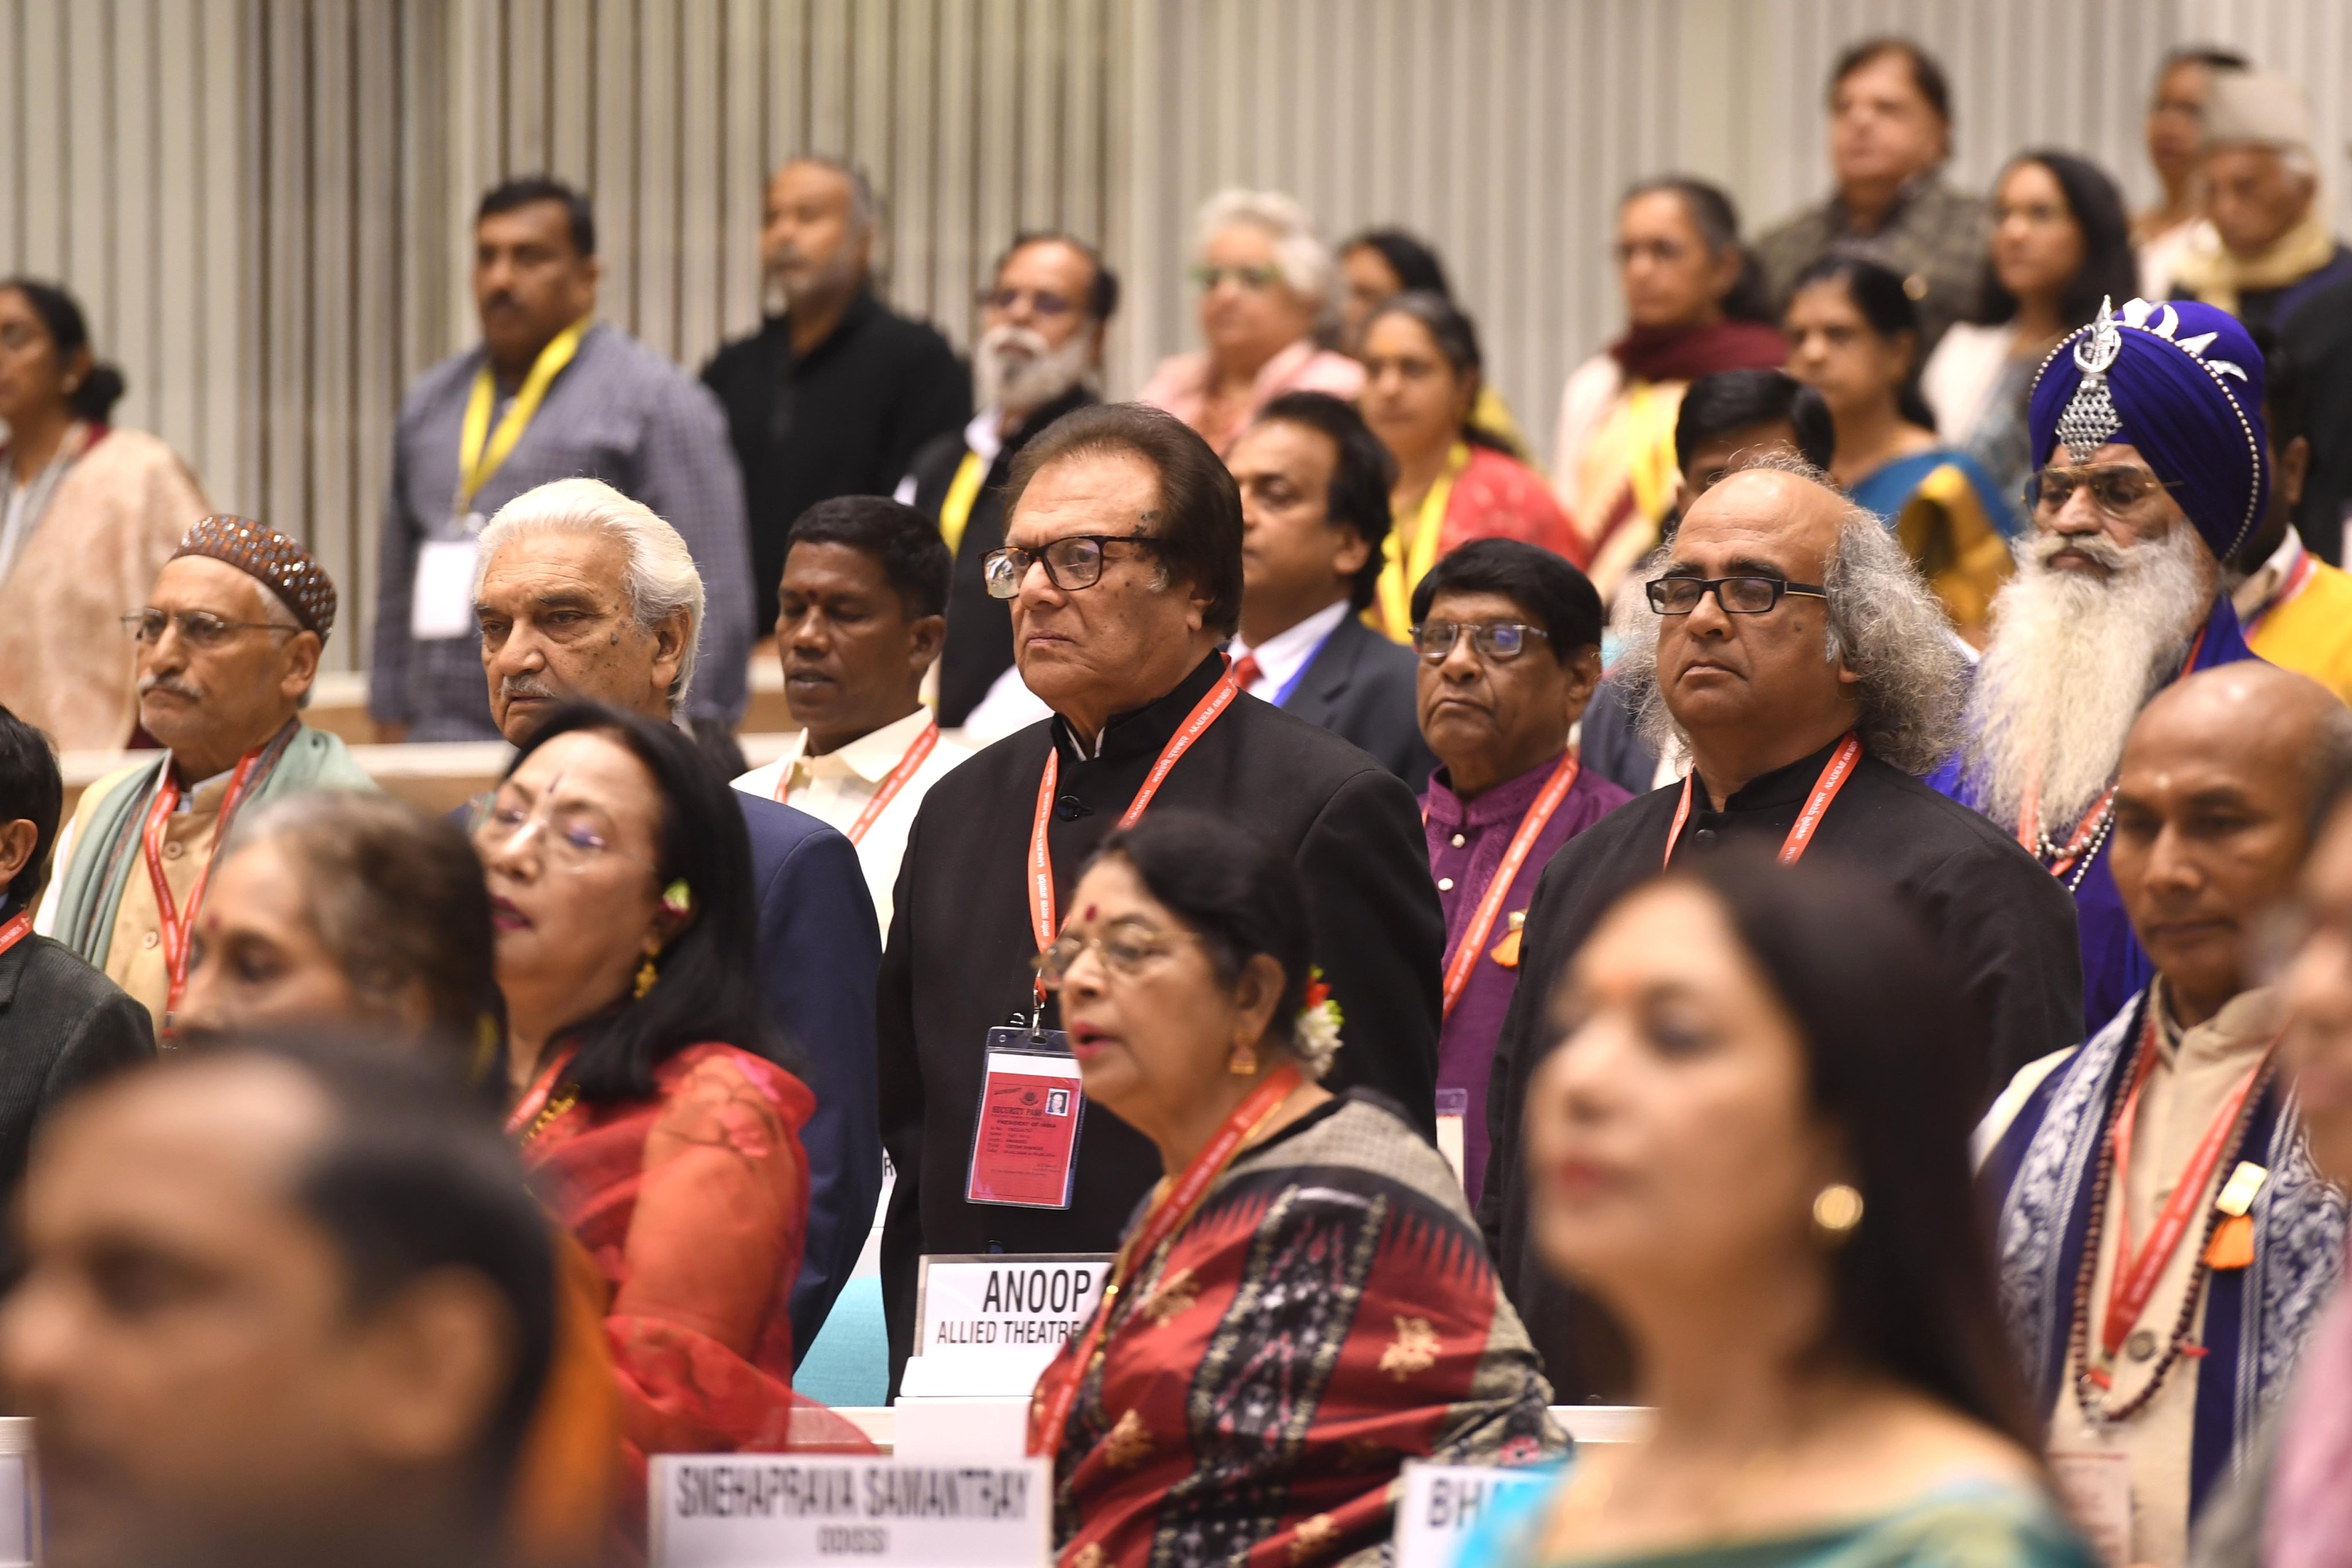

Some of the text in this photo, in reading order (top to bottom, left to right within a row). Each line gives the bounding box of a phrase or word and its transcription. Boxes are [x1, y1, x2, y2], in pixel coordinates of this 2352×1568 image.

[1189, 686, 1232, 734] AKADEMI AWARDS
[1824, 760, 1847, 790] AKADEMI
[982, 1269, 1091, 1313] ANOOP
[937, 1321, 997, 1344] ALLIED
[862, 1466, 1031, 1519] SAMANTRAY
